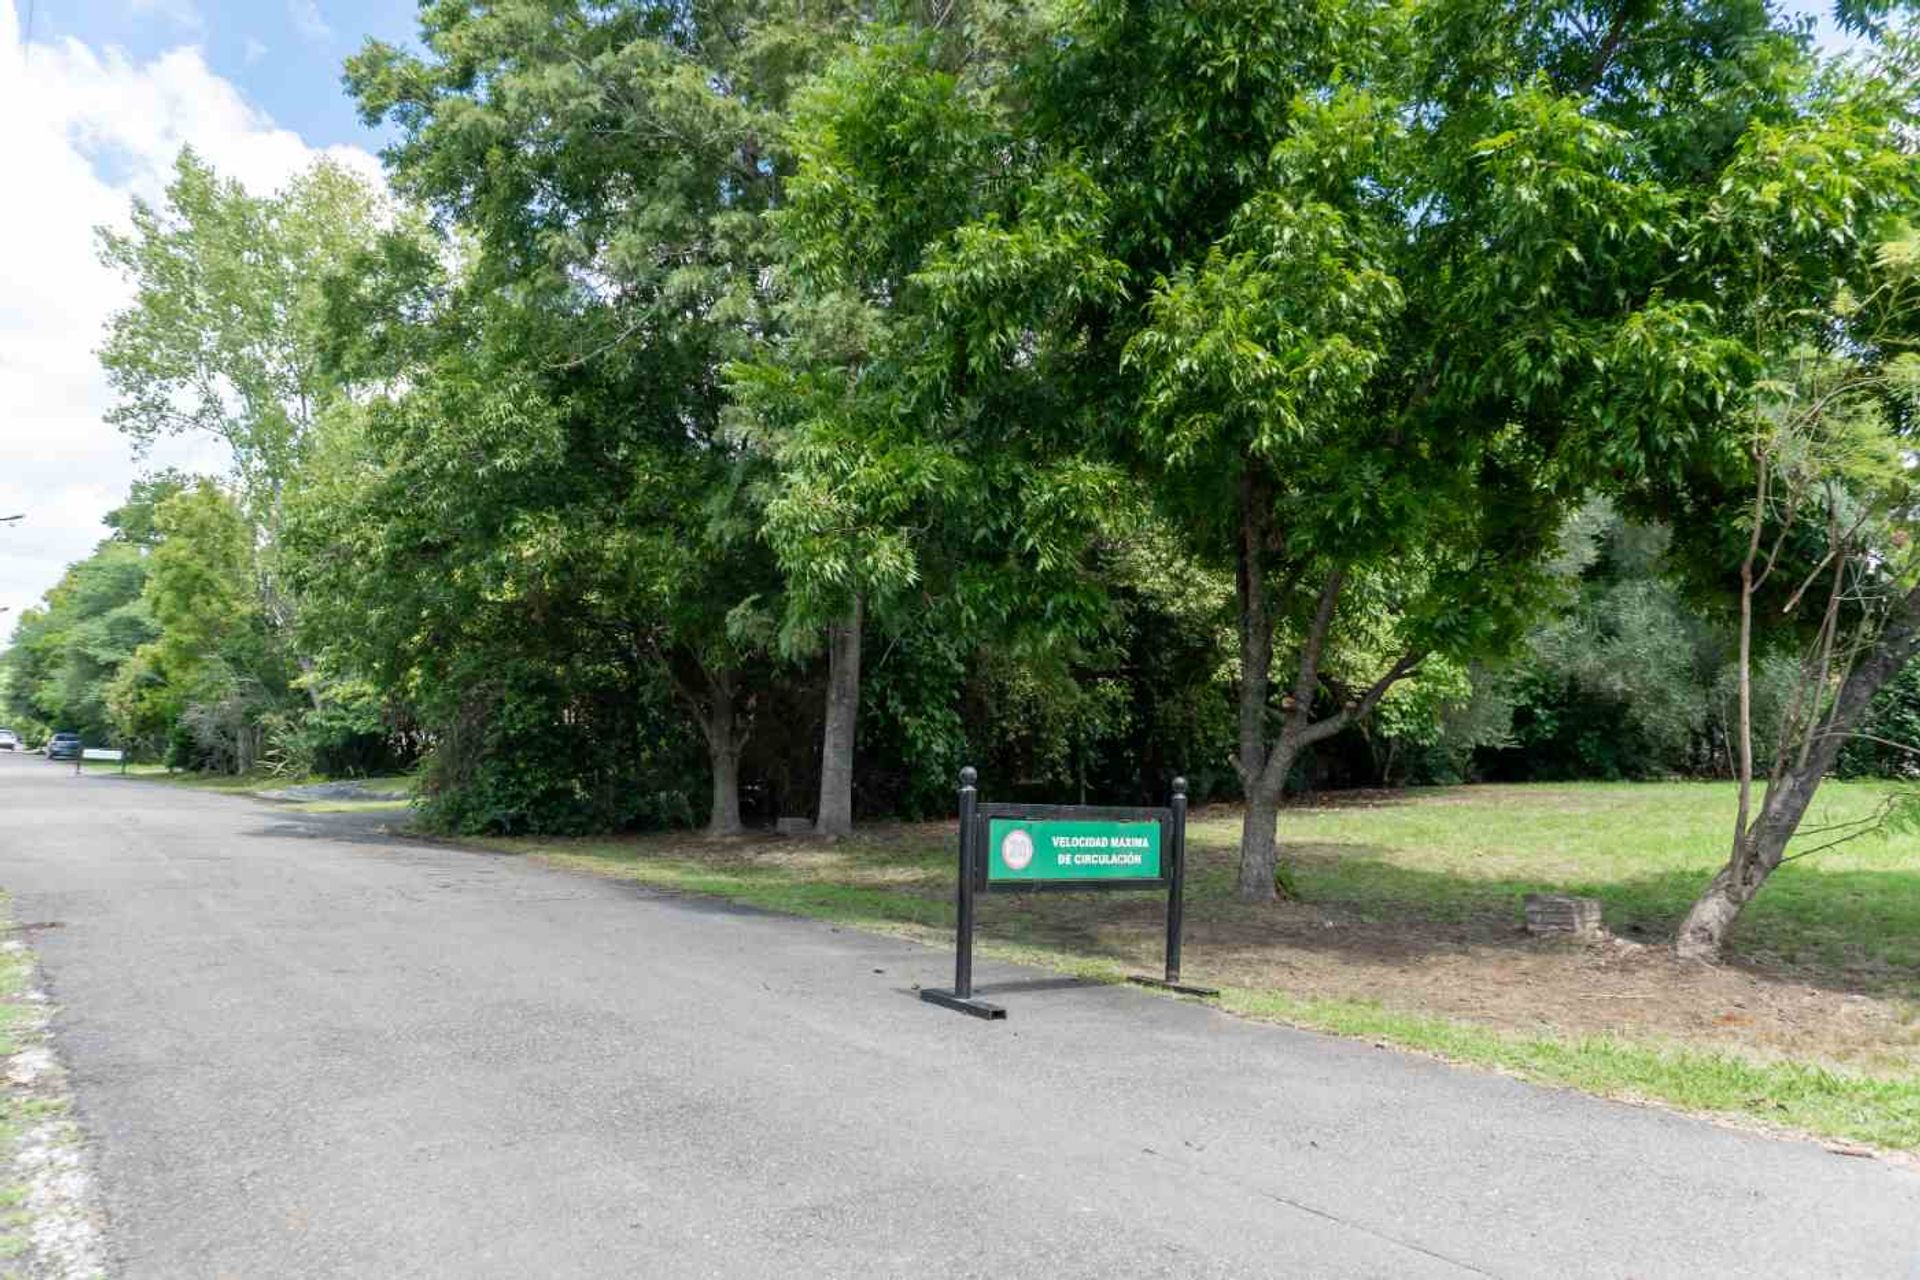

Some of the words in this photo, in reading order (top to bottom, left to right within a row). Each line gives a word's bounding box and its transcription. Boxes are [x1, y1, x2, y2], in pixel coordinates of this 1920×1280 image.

[1051, 836, 1108, 848] VELOCIDAD
[1057, 854, 1071, 865] DE
[1074, 852, 1142, 865] CIRCULACIÓN
